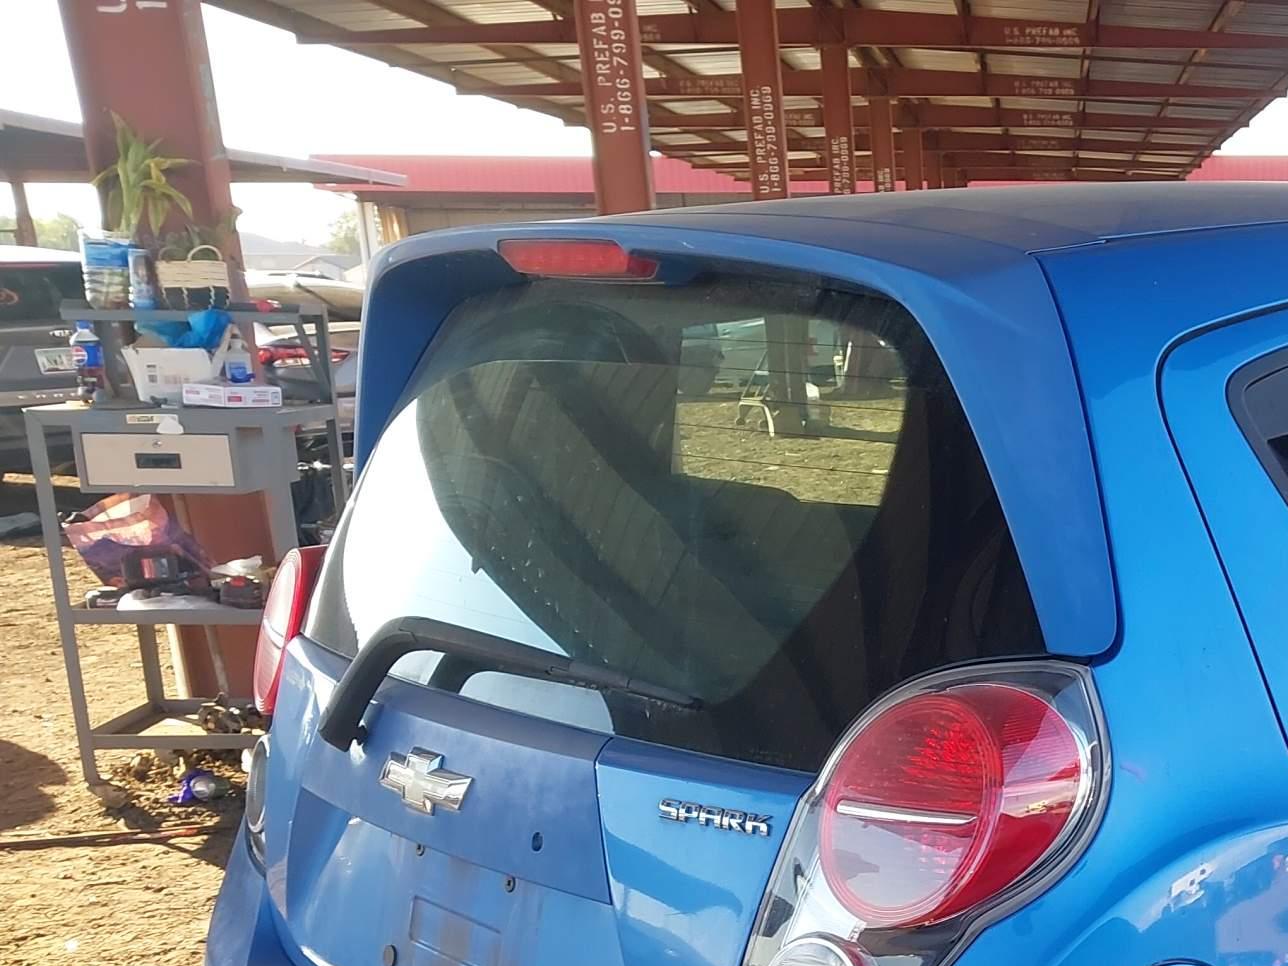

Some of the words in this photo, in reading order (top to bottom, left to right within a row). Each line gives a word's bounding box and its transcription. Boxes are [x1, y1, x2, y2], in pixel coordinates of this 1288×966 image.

[590, 12, 612, 87] PREFAB
[751, 115, 768, 164] PREFAB
[658, 798, 773, 837] SPARK
